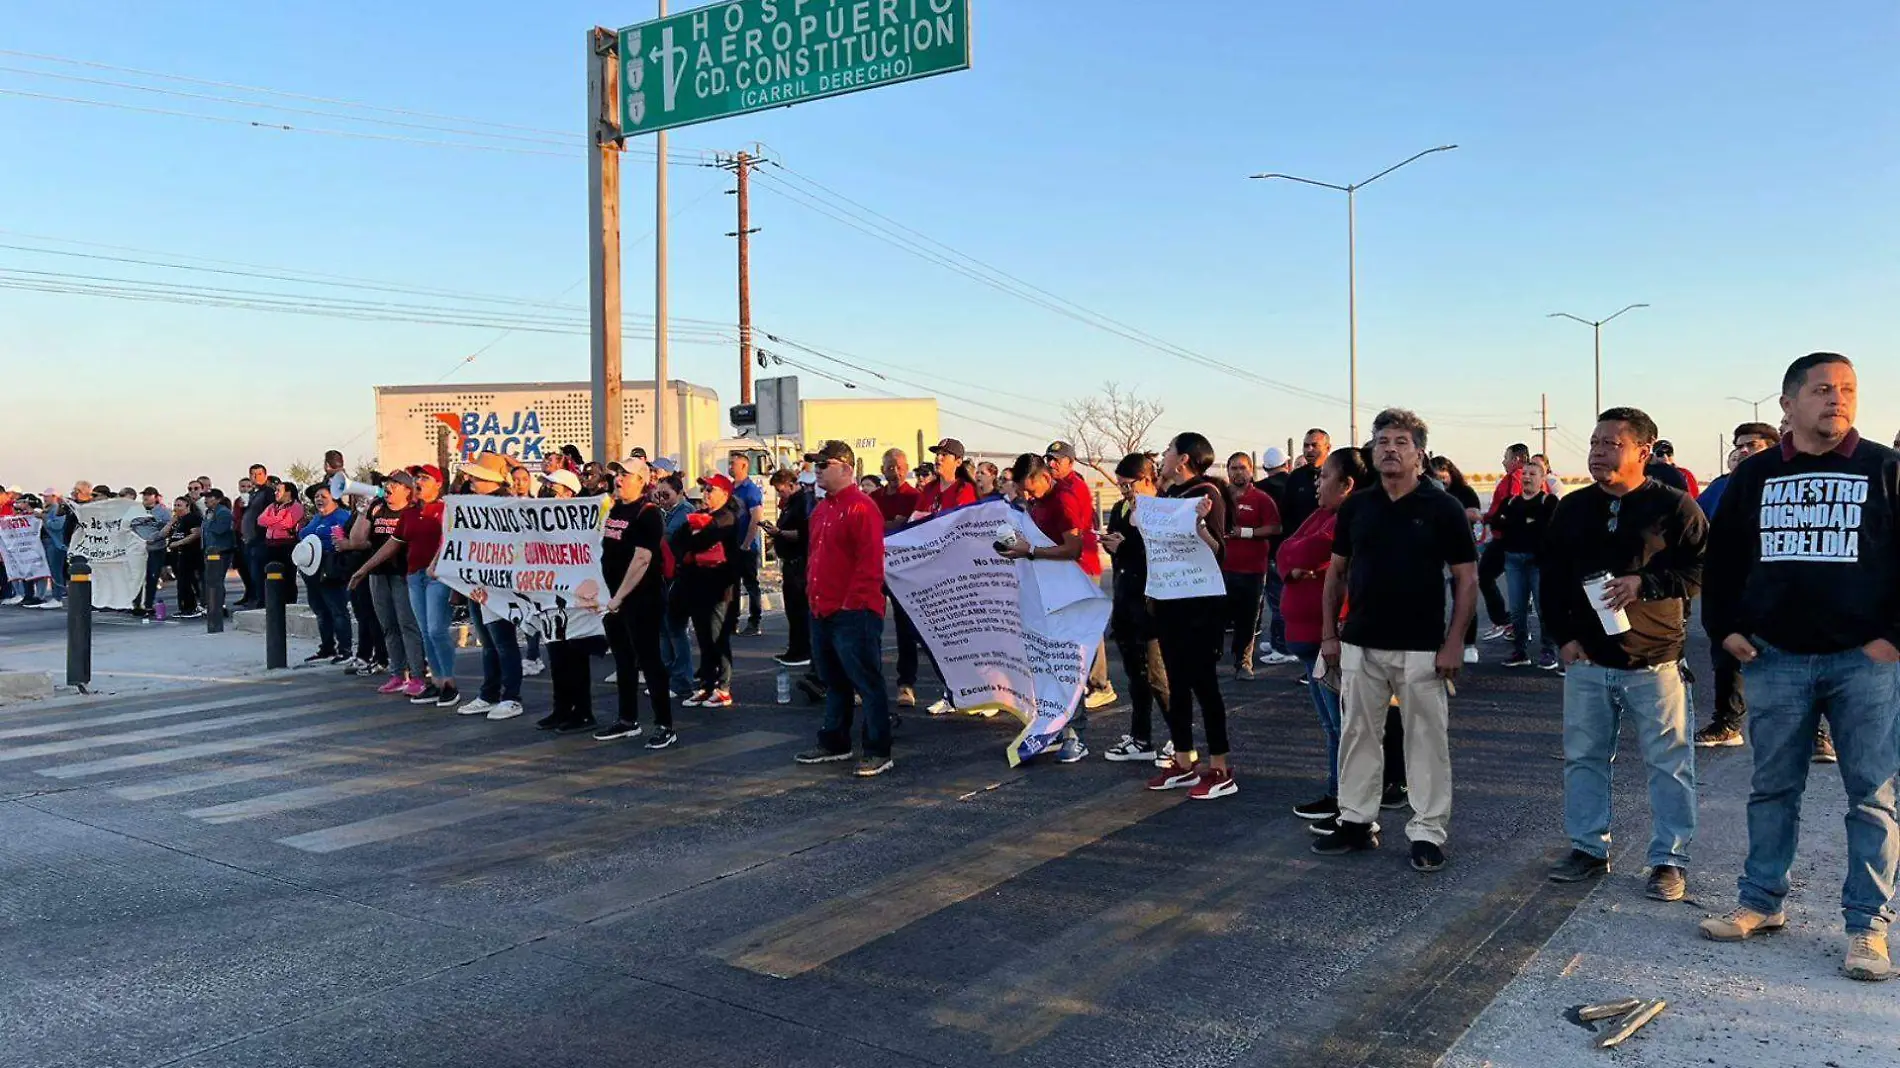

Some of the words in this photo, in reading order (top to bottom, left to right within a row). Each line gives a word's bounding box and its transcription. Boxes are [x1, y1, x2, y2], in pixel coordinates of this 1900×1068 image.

[695, 67, 730, 98] CD.
[736, 13, 954, 90] CONSTITUCION
[741, 80, 810, 109] (CARRIL
[819, 56, 913, 91] DERECHO)
[461, 411, 541, 436] BAJA
[461, 436, 546, 462] PACK
[1761, 479, 1869, 506] MAESTRO
[1760, 503, 1862, 529] DIGNIDAD
[443, 540, 463, 561] AL
[468, 541, 514, 565] PUCHAS
[973, 558, 988, 567] No
